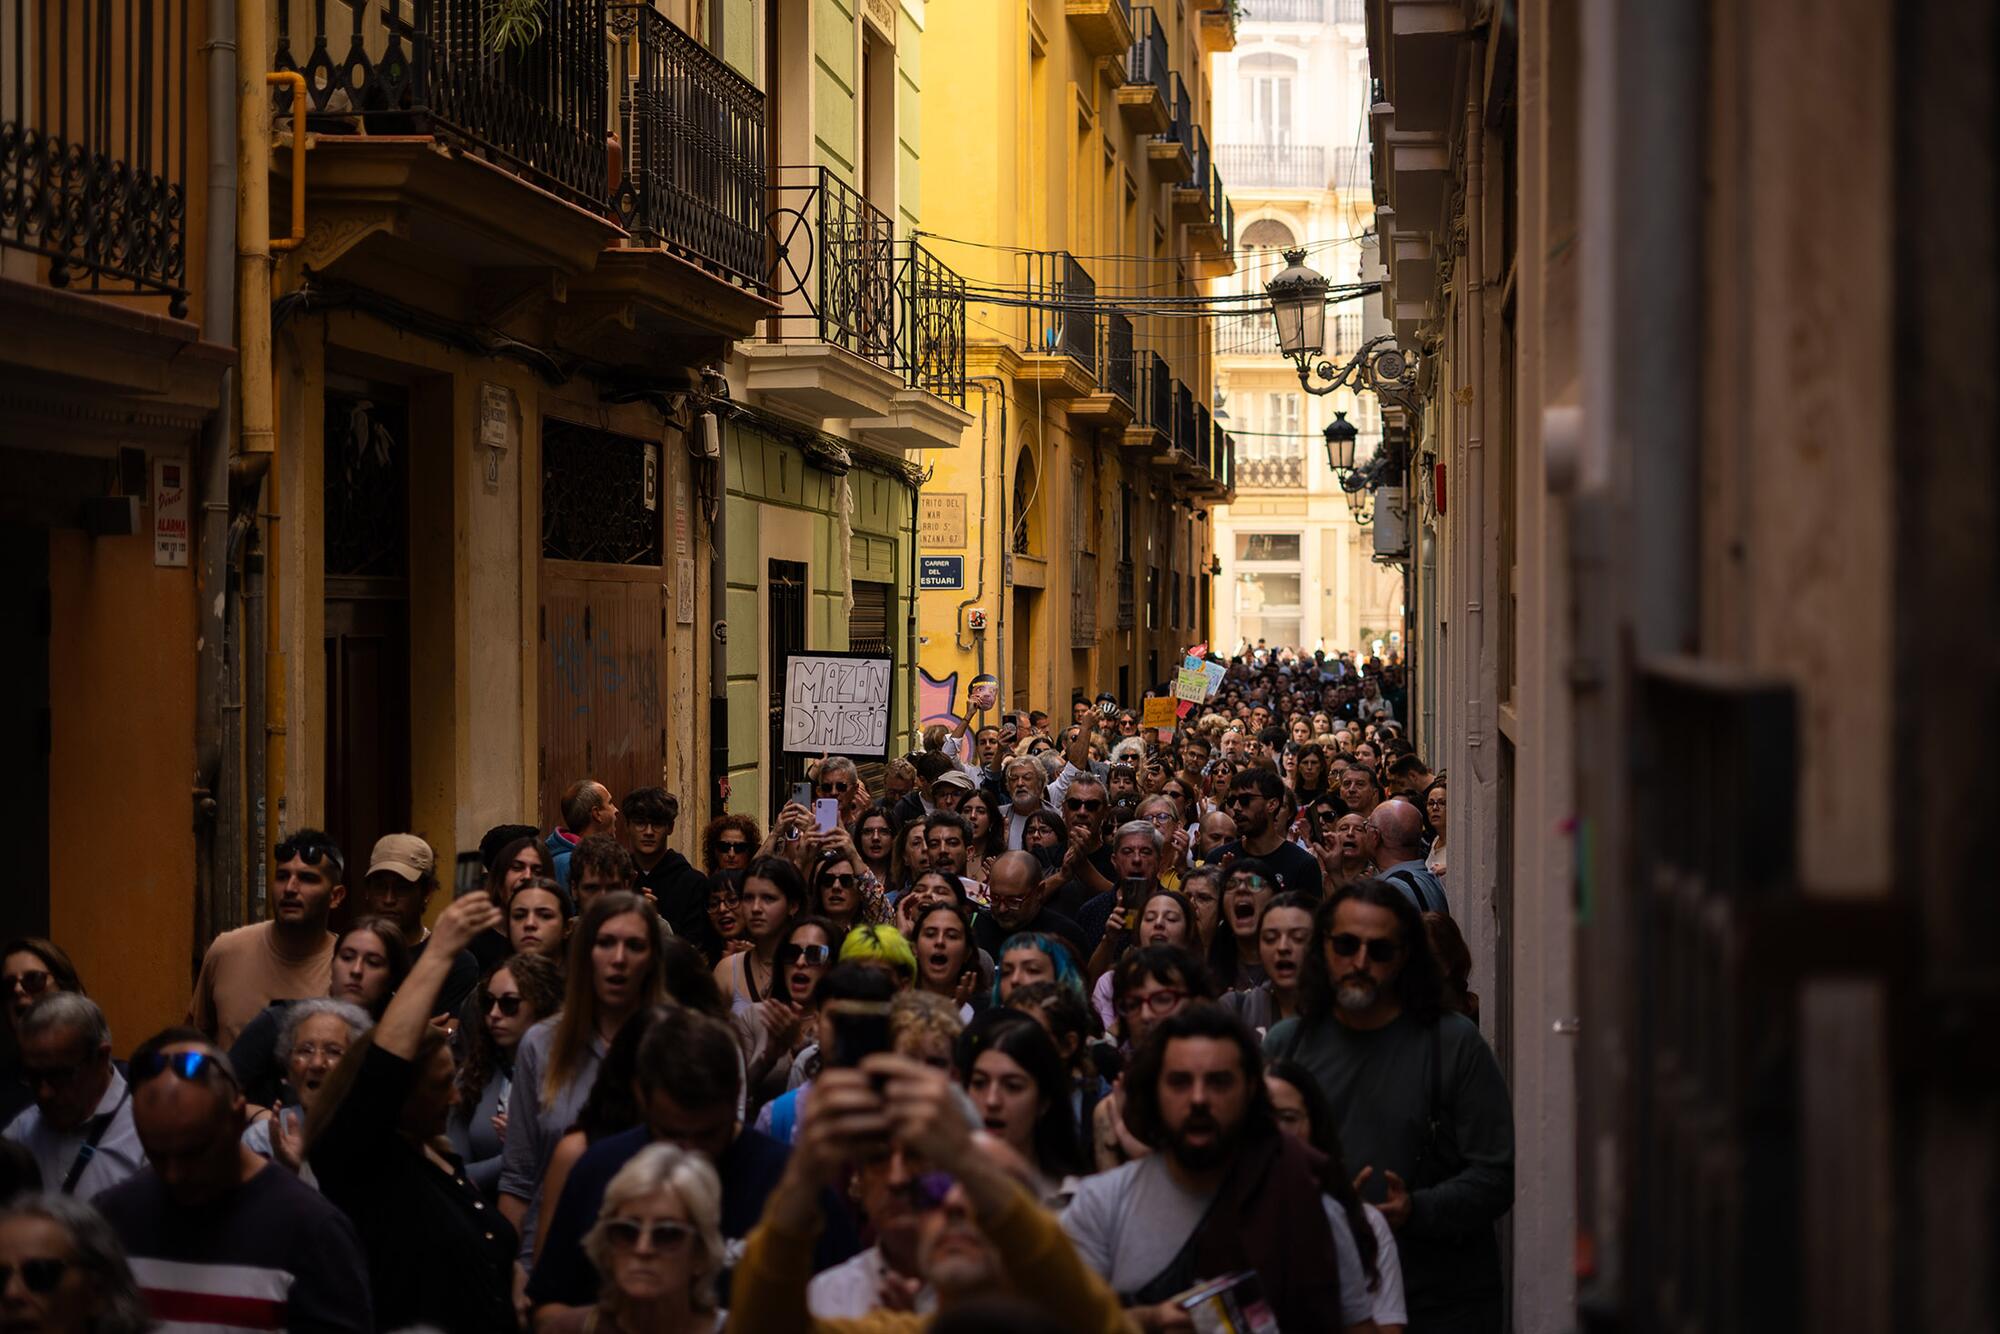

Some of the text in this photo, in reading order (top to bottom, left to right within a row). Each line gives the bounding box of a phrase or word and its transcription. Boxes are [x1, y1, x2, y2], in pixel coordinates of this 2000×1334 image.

[645, 460, 655, 500] B
[946, 498, 960, 508] DEL
[927, 511, 941, 519] MAR
[158, 519, 186, 534] ALARMA
[793, 660, 889, 704] MAZÓN
